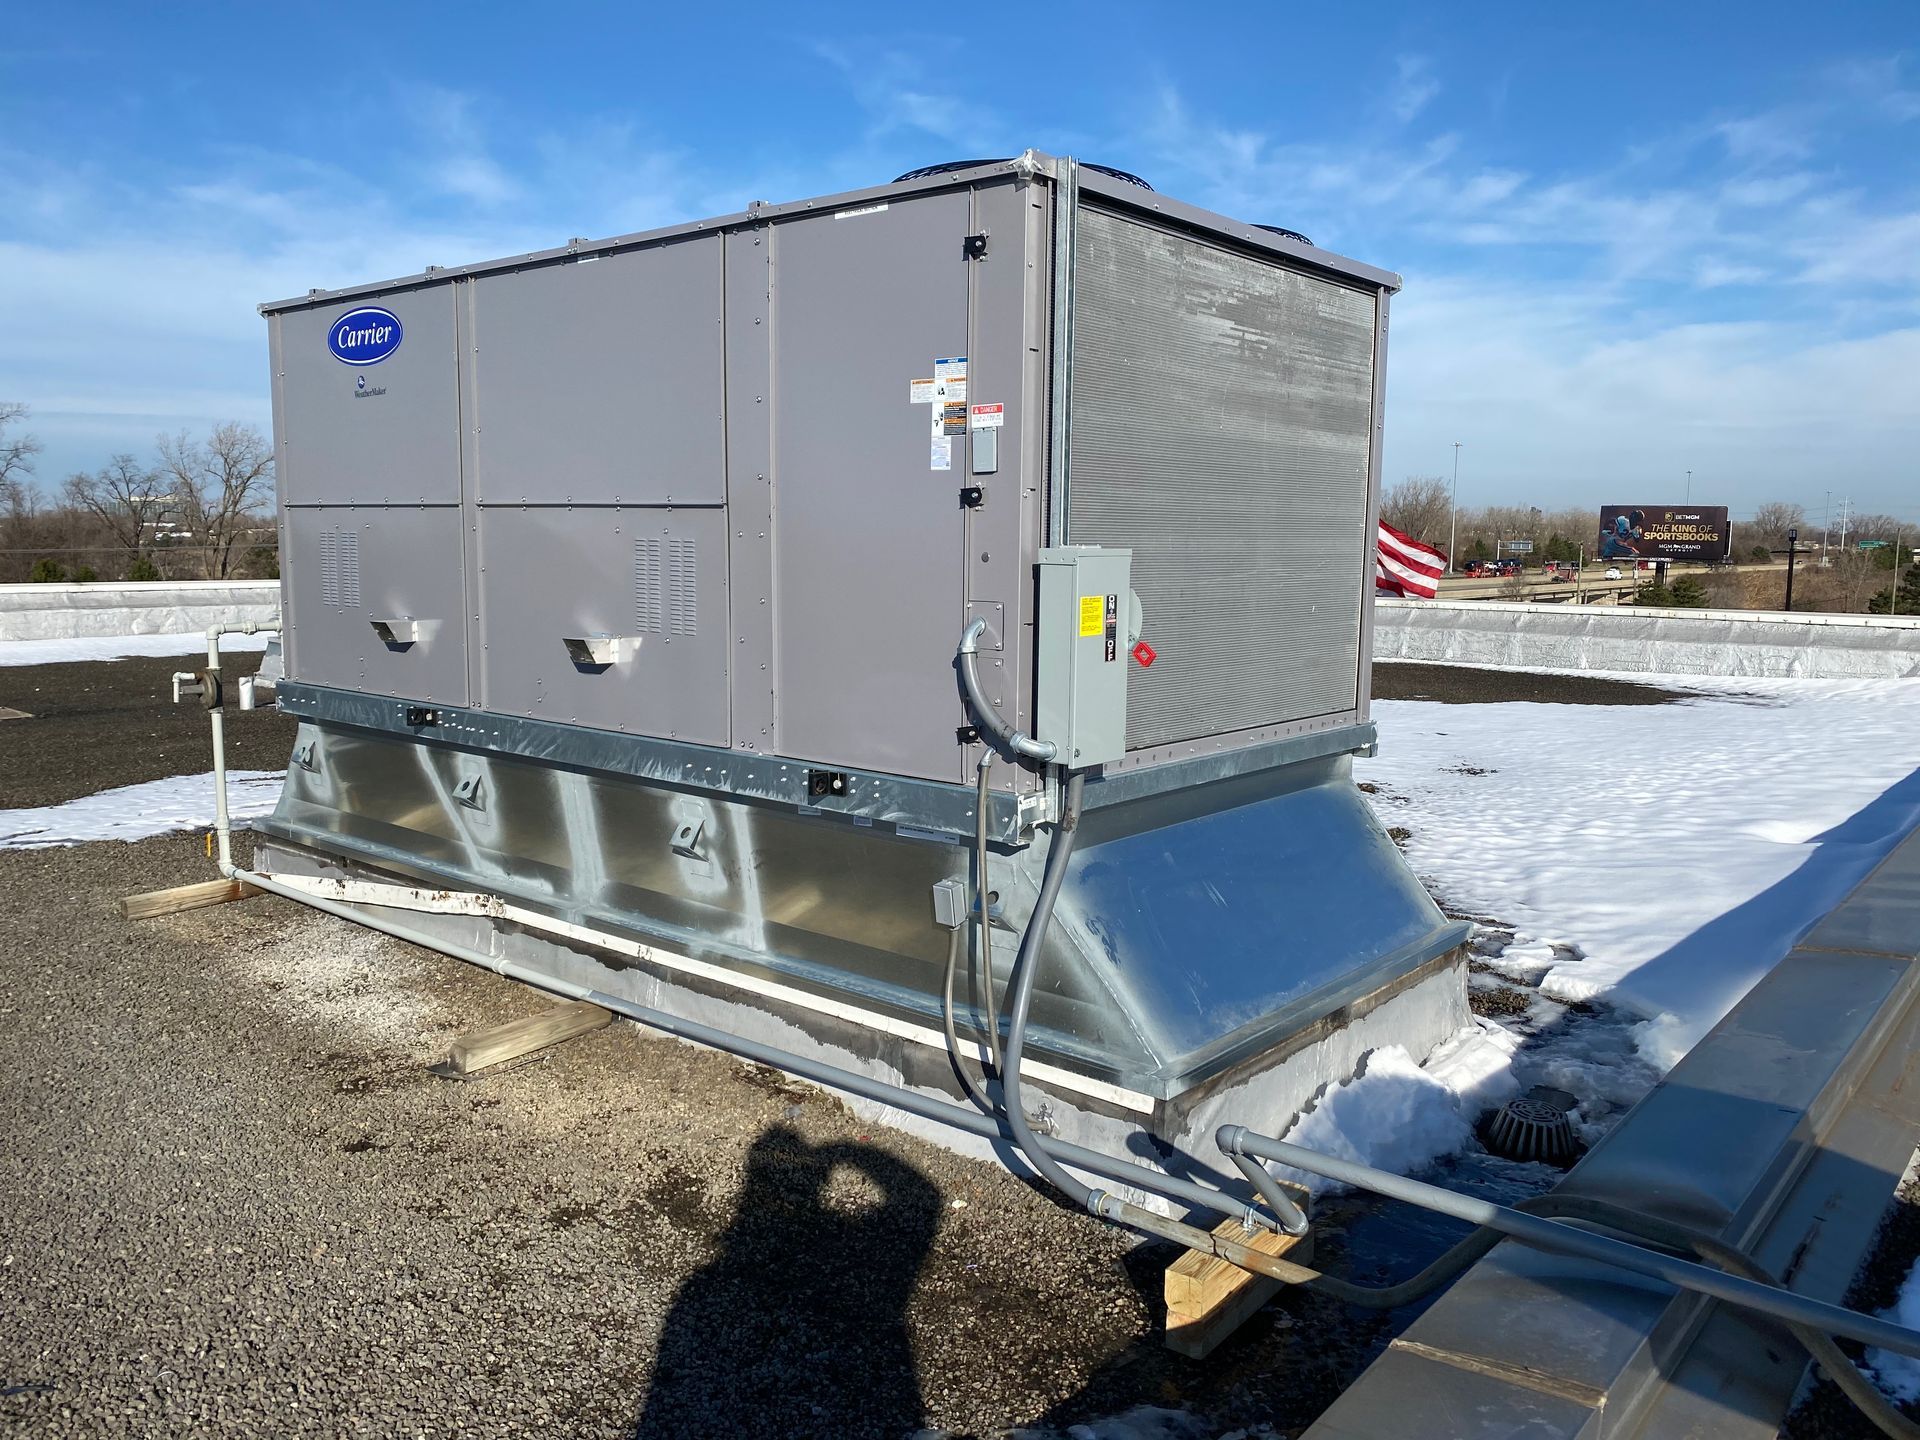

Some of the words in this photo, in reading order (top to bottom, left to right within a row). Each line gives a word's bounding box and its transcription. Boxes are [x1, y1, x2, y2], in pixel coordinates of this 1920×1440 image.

[338, 322, 392, 348] Carrier
[979, 405, 998, 414] DANGER
[1651, 524, 1670, 532] THE
[1671, 524, 1697, 533] KING
[1698, 525, 1713, 533] OF
[1643, 532, 1719, 541] SPORTSBOOKS
[1108, 595, 1115, 609] ON
